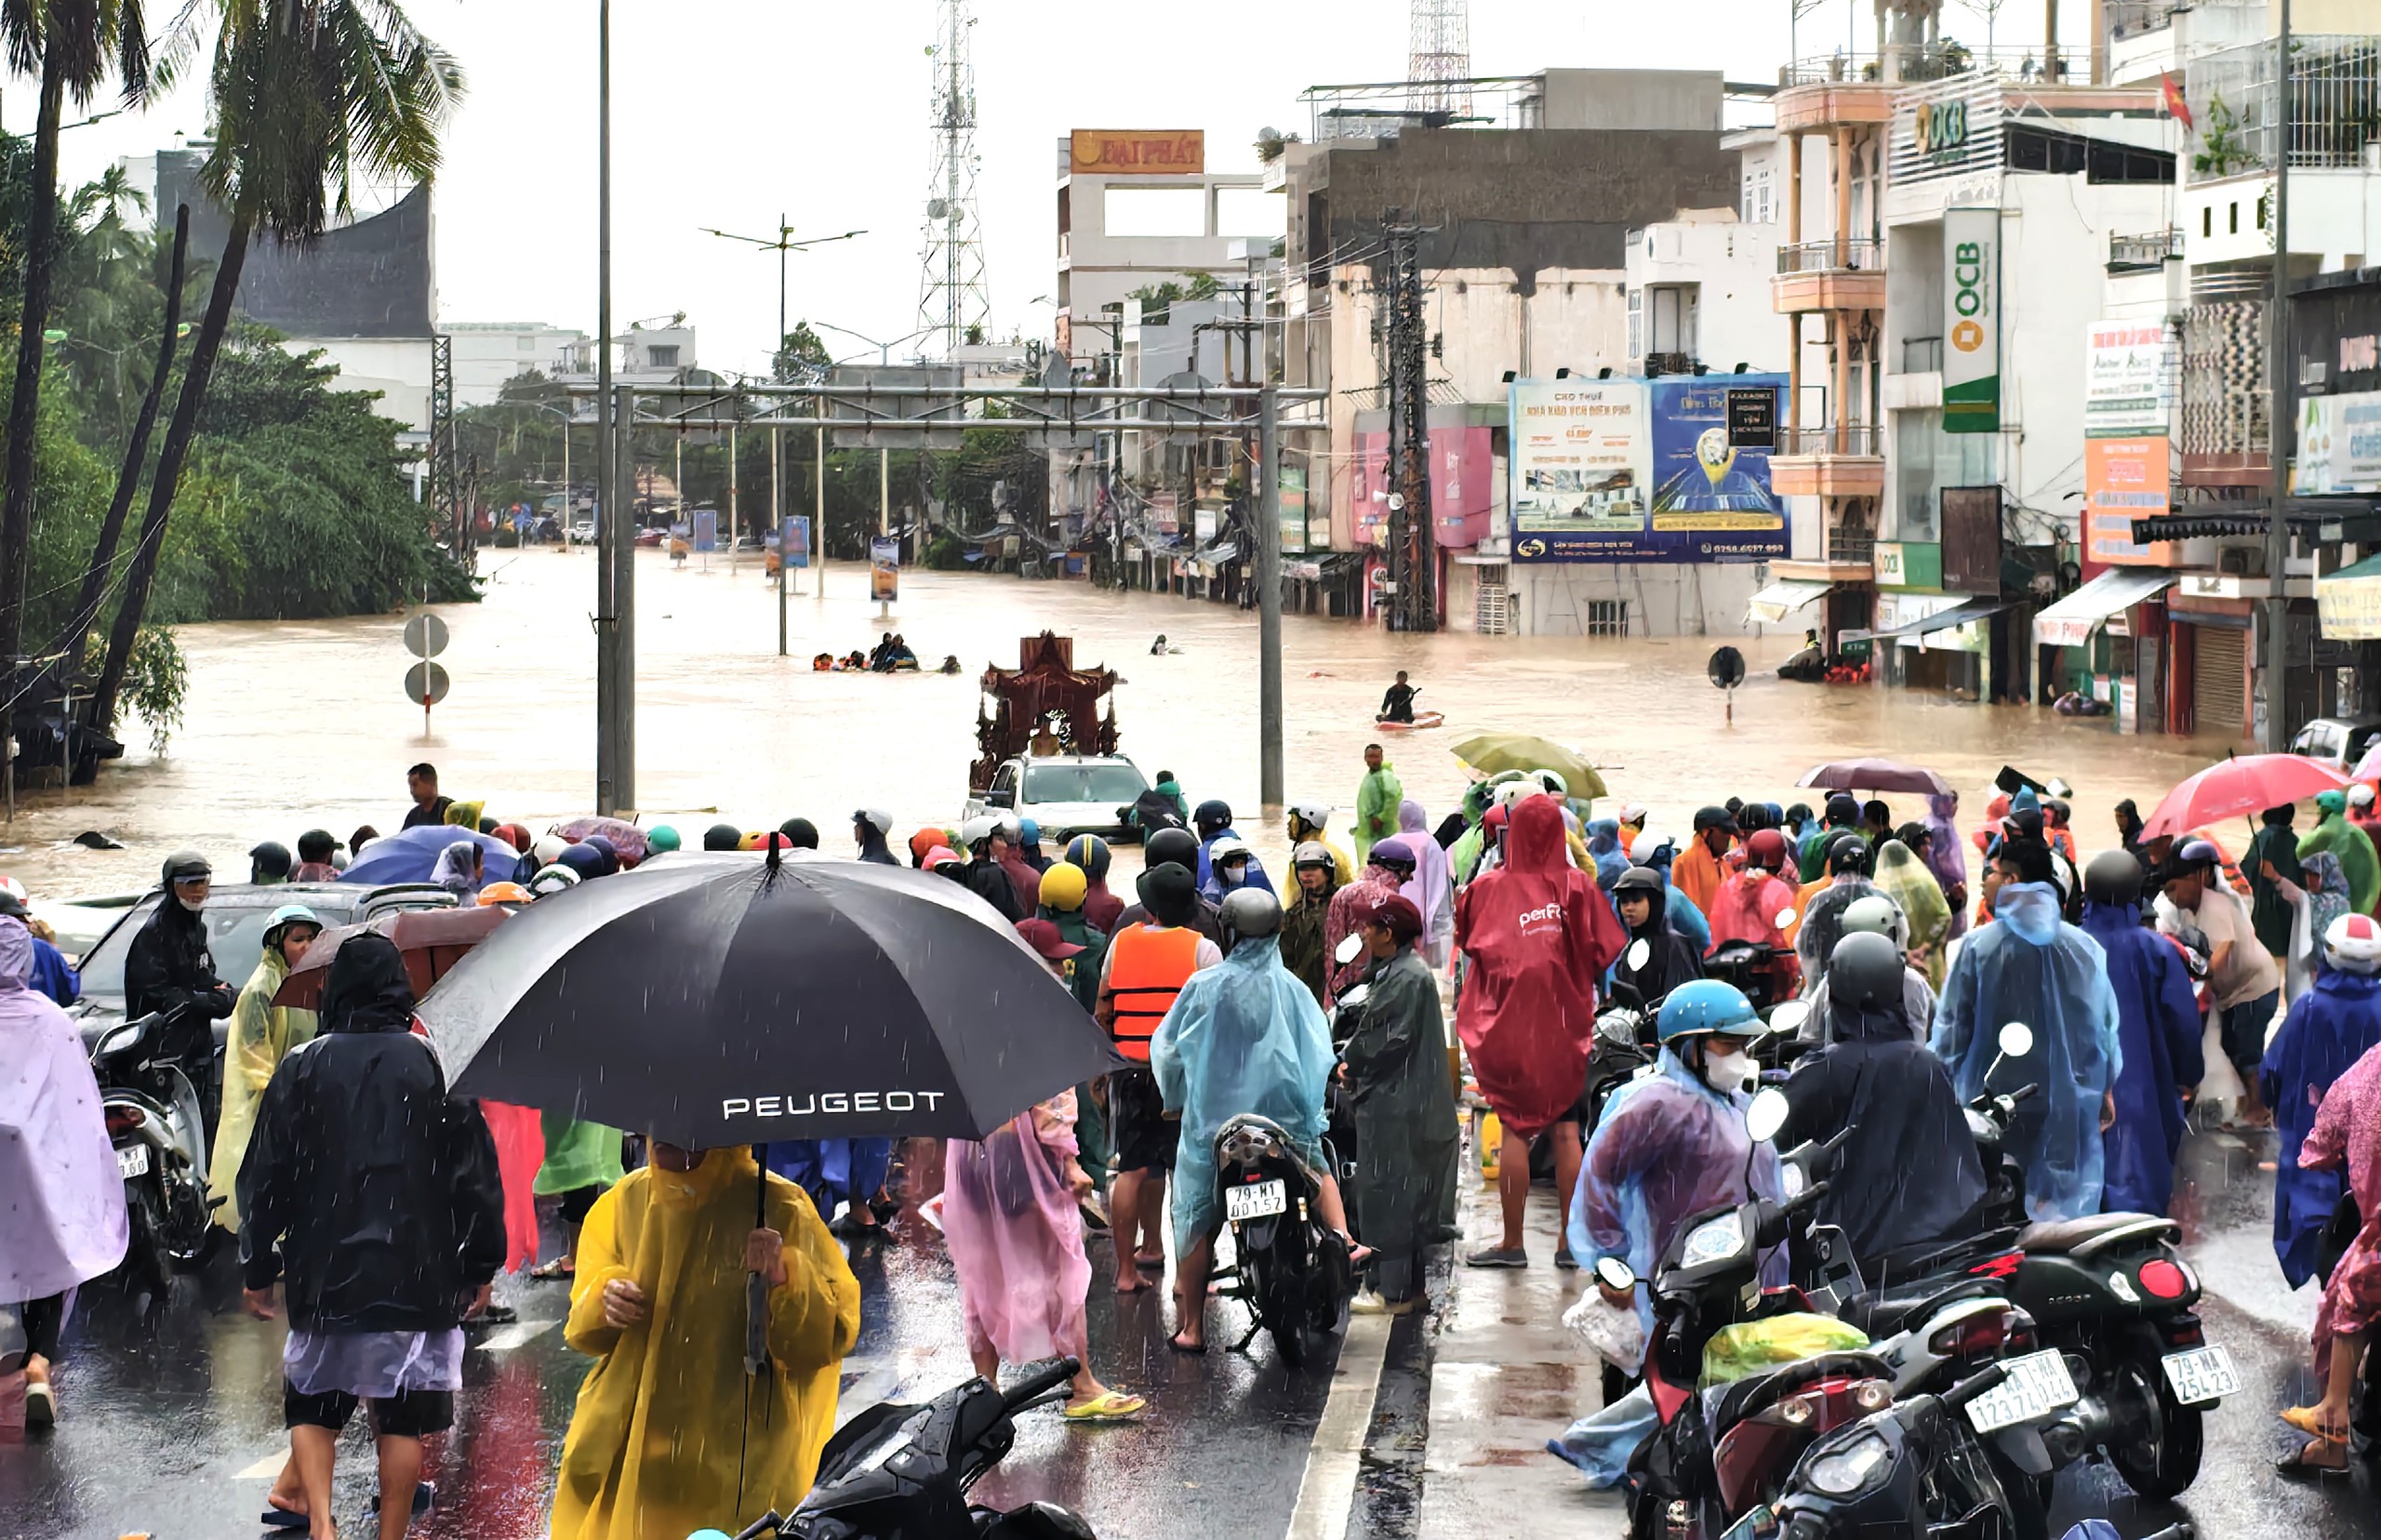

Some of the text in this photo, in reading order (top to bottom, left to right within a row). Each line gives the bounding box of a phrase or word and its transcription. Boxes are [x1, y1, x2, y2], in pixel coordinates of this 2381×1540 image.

[1931, 100, 1966, 149] OCB
[1955, 242, 1980, 316] OCB
[723, 1091, 945, 1121] PEUGEOT
[1975, 1391, 2042, 1427] 123.74
